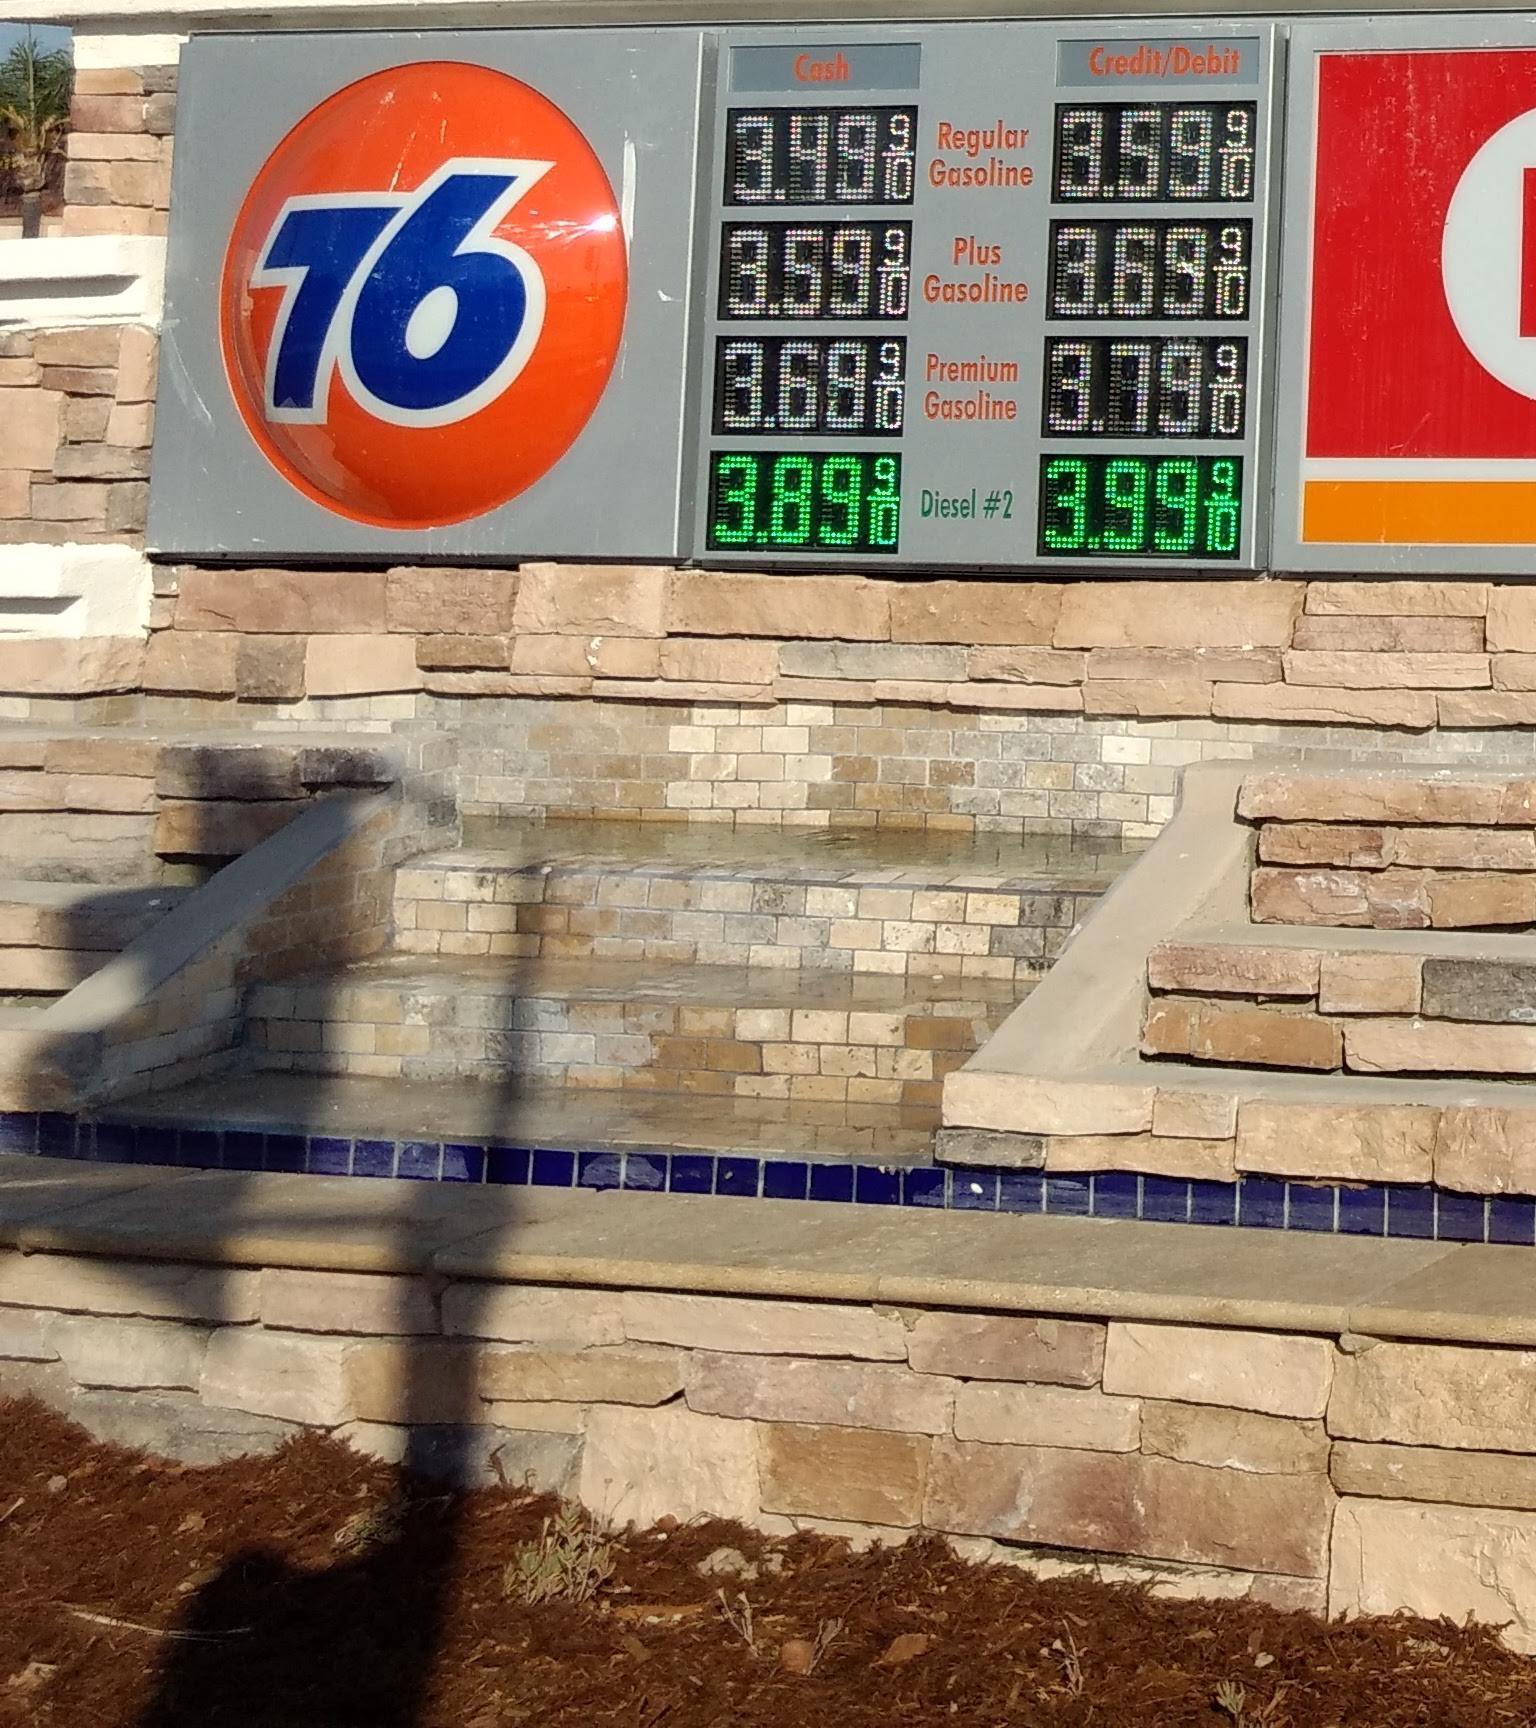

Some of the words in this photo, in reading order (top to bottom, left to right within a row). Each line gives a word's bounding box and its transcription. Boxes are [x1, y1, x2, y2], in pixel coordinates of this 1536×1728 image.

[794, 51, 850, 82] Cash
[1088, 45, 1241, 79] Credit/Debit
[936, 119, 1030, 158] Regular
[929, 156, 1034, 188] Gasoline
[952, 235, 1002, 266] Plus
[250, 157, 556, 428] 76
[923, 272, 1029, 304] Gasoline
[925, 352, 1019, 383] Premium
[924, 389, 1018, 421] Gasoline
[920, 488, 977, 519] Diesel
[983, 489, 1014, 520] #2
